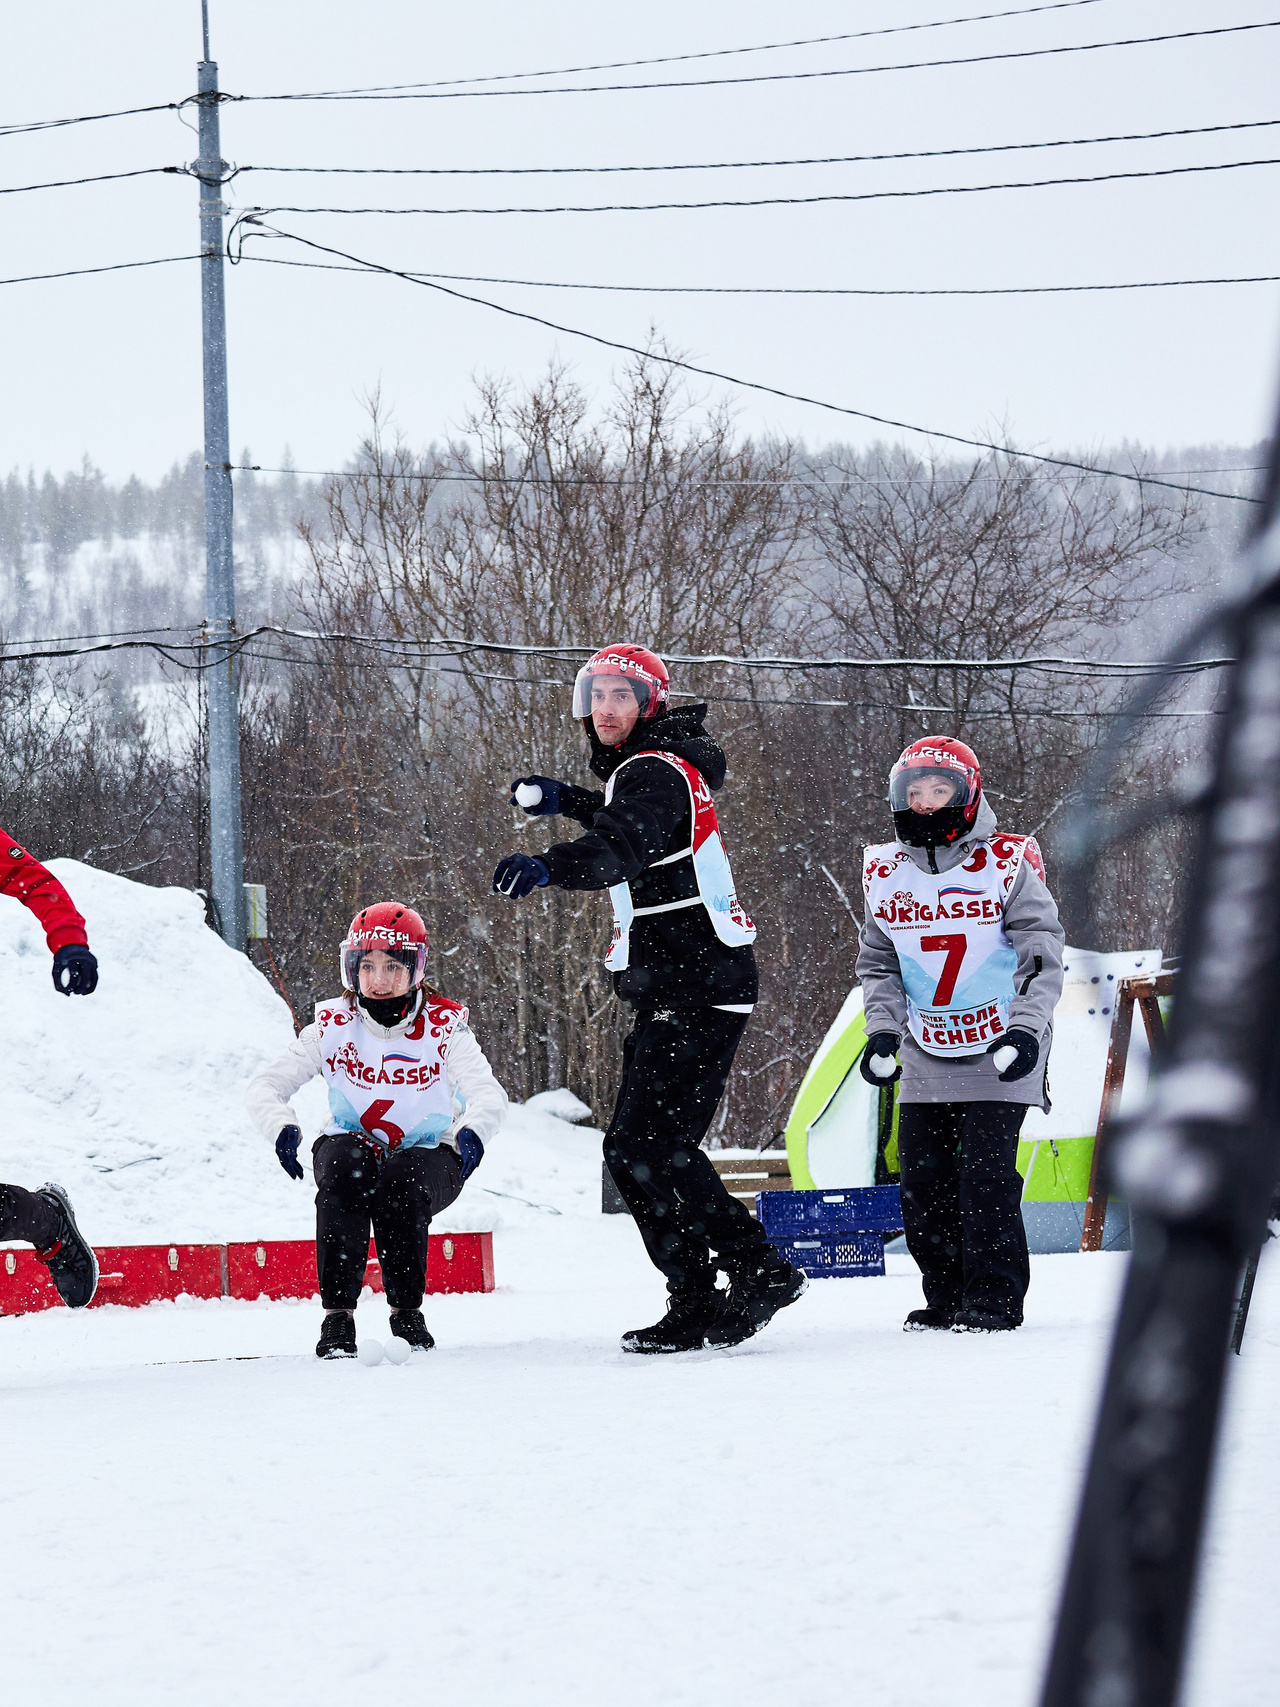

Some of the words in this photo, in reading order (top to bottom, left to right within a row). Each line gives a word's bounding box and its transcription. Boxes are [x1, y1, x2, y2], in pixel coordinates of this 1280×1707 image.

[920, 933, 968, 1007] 7
[923, 1026, 931, 1043] В
[934, 1016, 1004, 1045] СНЕГЕ
[949, 1003, 998, 1027] ТОЛК
[360, 1099, 406, 1152] 6
